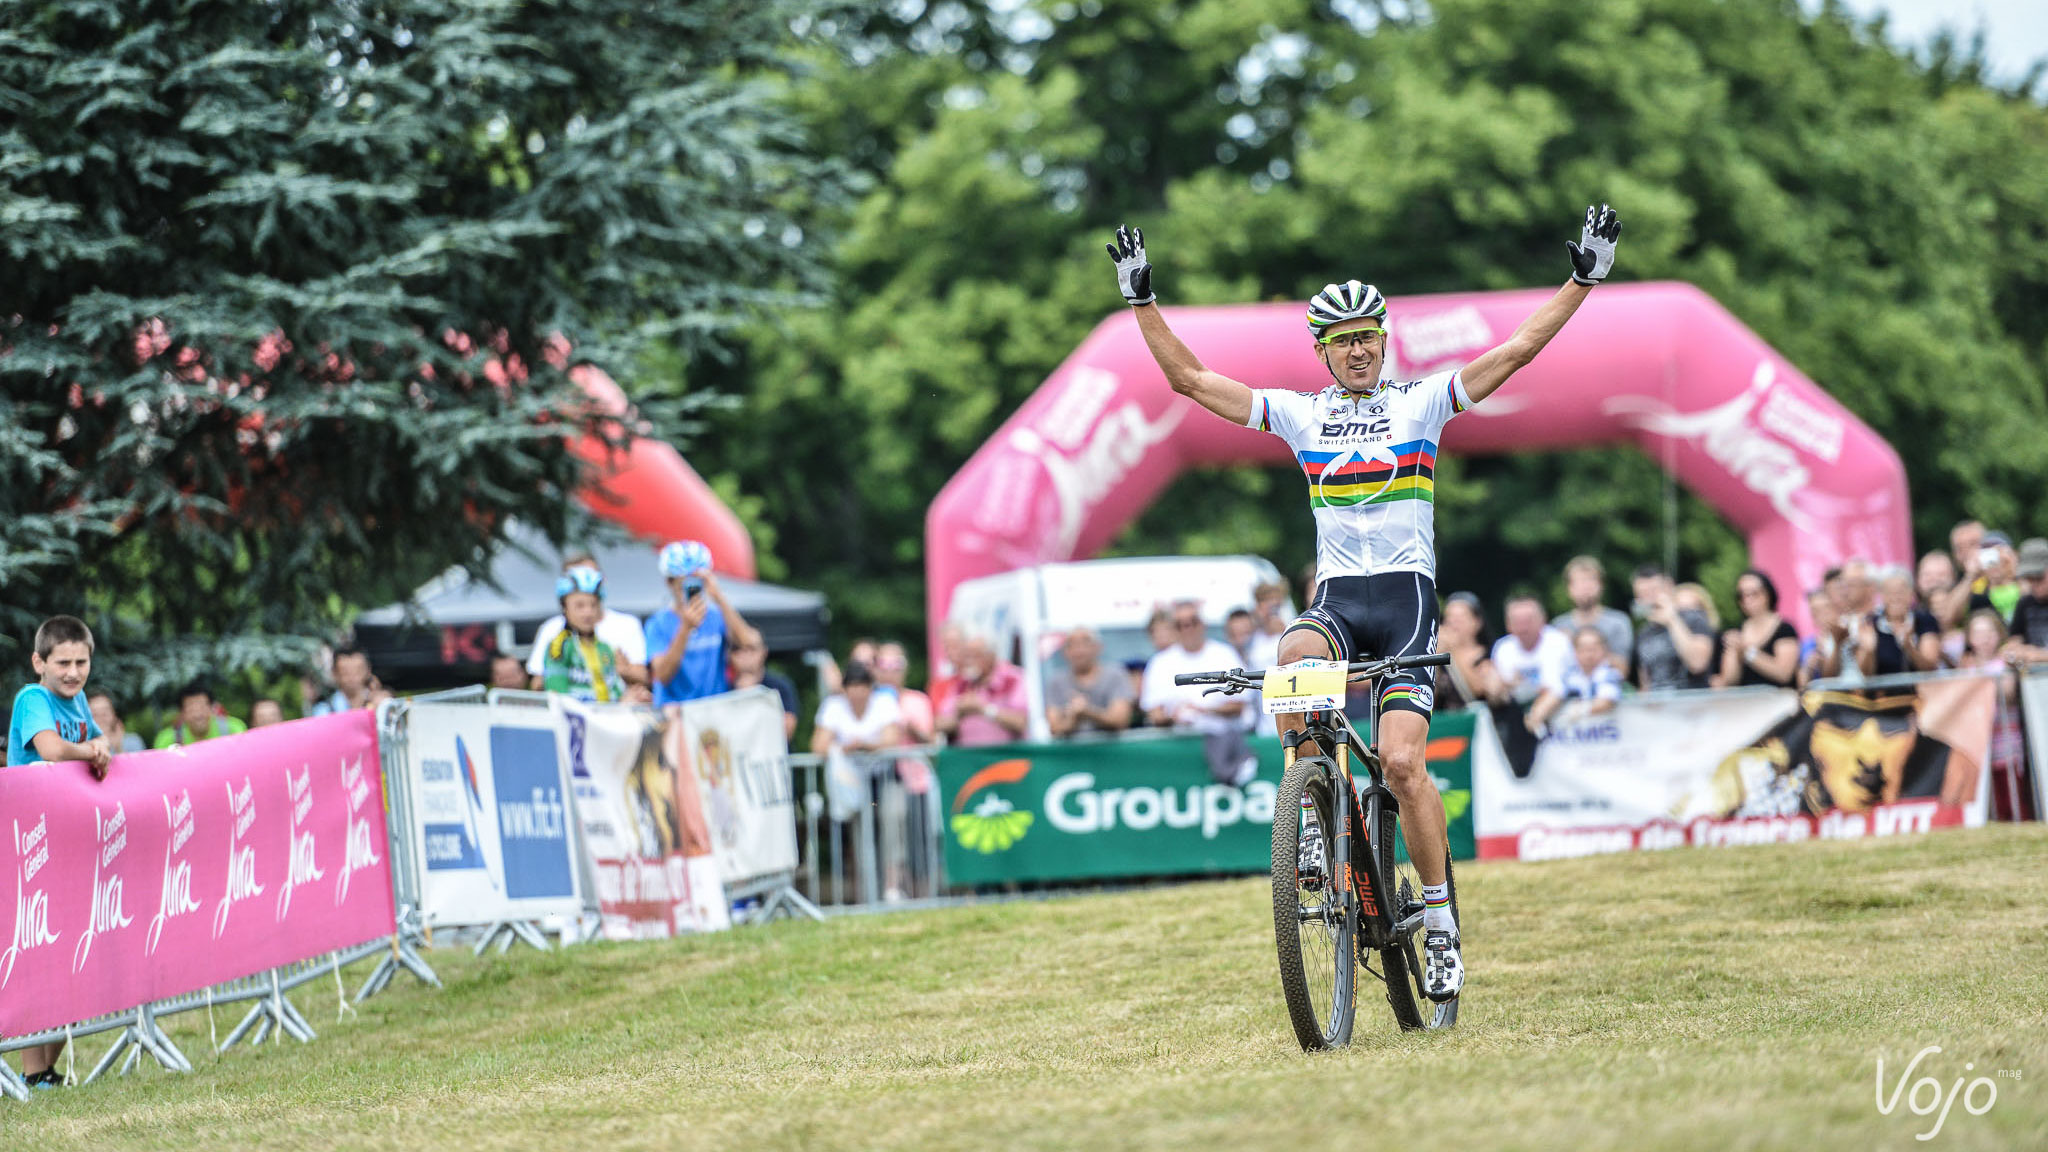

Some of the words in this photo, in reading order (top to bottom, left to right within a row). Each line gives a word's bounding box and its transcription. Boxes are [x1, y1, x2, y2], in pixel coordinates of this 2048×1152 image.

[1318, 436, 1382, 445] SWITZERLAND
[1320, 419, 1390, 437] BMC
[1288, 676, 1297, 693] 1
[103, 801, 127, 843] Conseil
[1044, 771, 1277, 839] Groupa
[22, 812, 47, 856] Conseil
[102, 824, 128, 869] Général
[24, 838, 50, 883] Général
[1354, 871, 1379, 917] BMC
